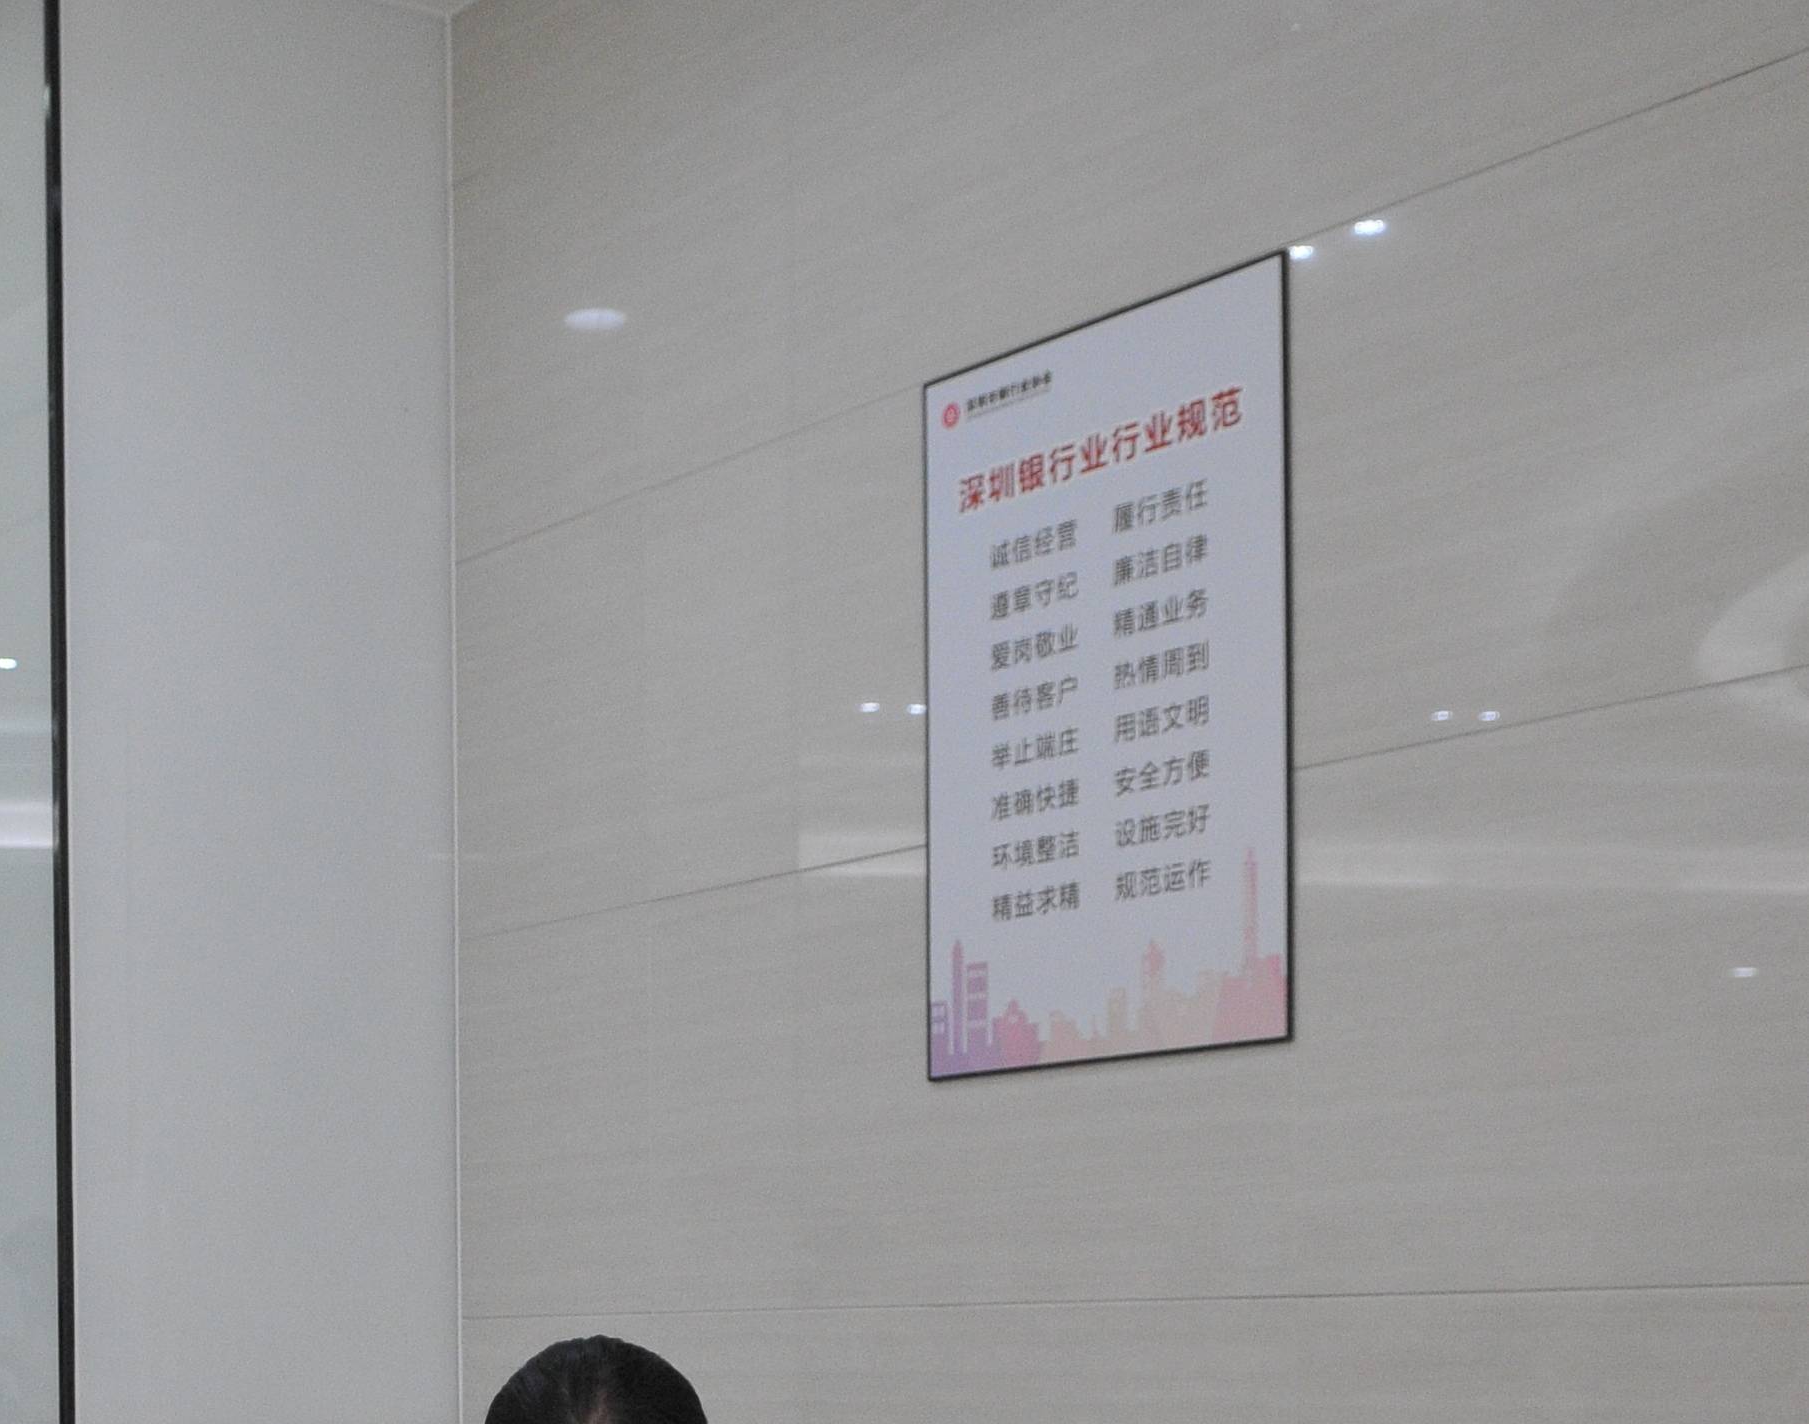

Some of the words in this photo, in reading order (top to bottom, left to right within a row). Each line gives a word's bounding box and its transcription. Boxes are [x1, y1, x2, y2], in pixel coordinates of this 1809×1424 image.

[958, 386, 1243, 513] 深圳银行业行业规范
[1112, 478, 1208, 534] 履行责任
[991, 519, 1078, 569] 诚信经营
[1112, 534, 1208, 587] 廉洁自律
[991, 572, 1079, 620] 遵章守纪
[1113, 588, 1209, 638] 精通业务
[991, 624, 1078, 671] 爱岗敬业
[1114, 640, 1210, 690] 热情周到
[991, 674, 1079, 722] 善待客户
[1114, 695, 1210, 744] 用语文明
[991, 727, 1080, 771] 举止端庄
[1114, 748, 1211, 797] 安全方便
[992, 778, 1080, 822] 准确快捷
[1115, 803, 1212, 849] 设施完好
[992, 831, 1080, 872] 环境整洁
[992, 881, 1081, 923] 精益求精
[1115, 858, 1212, 902] 规范运作
